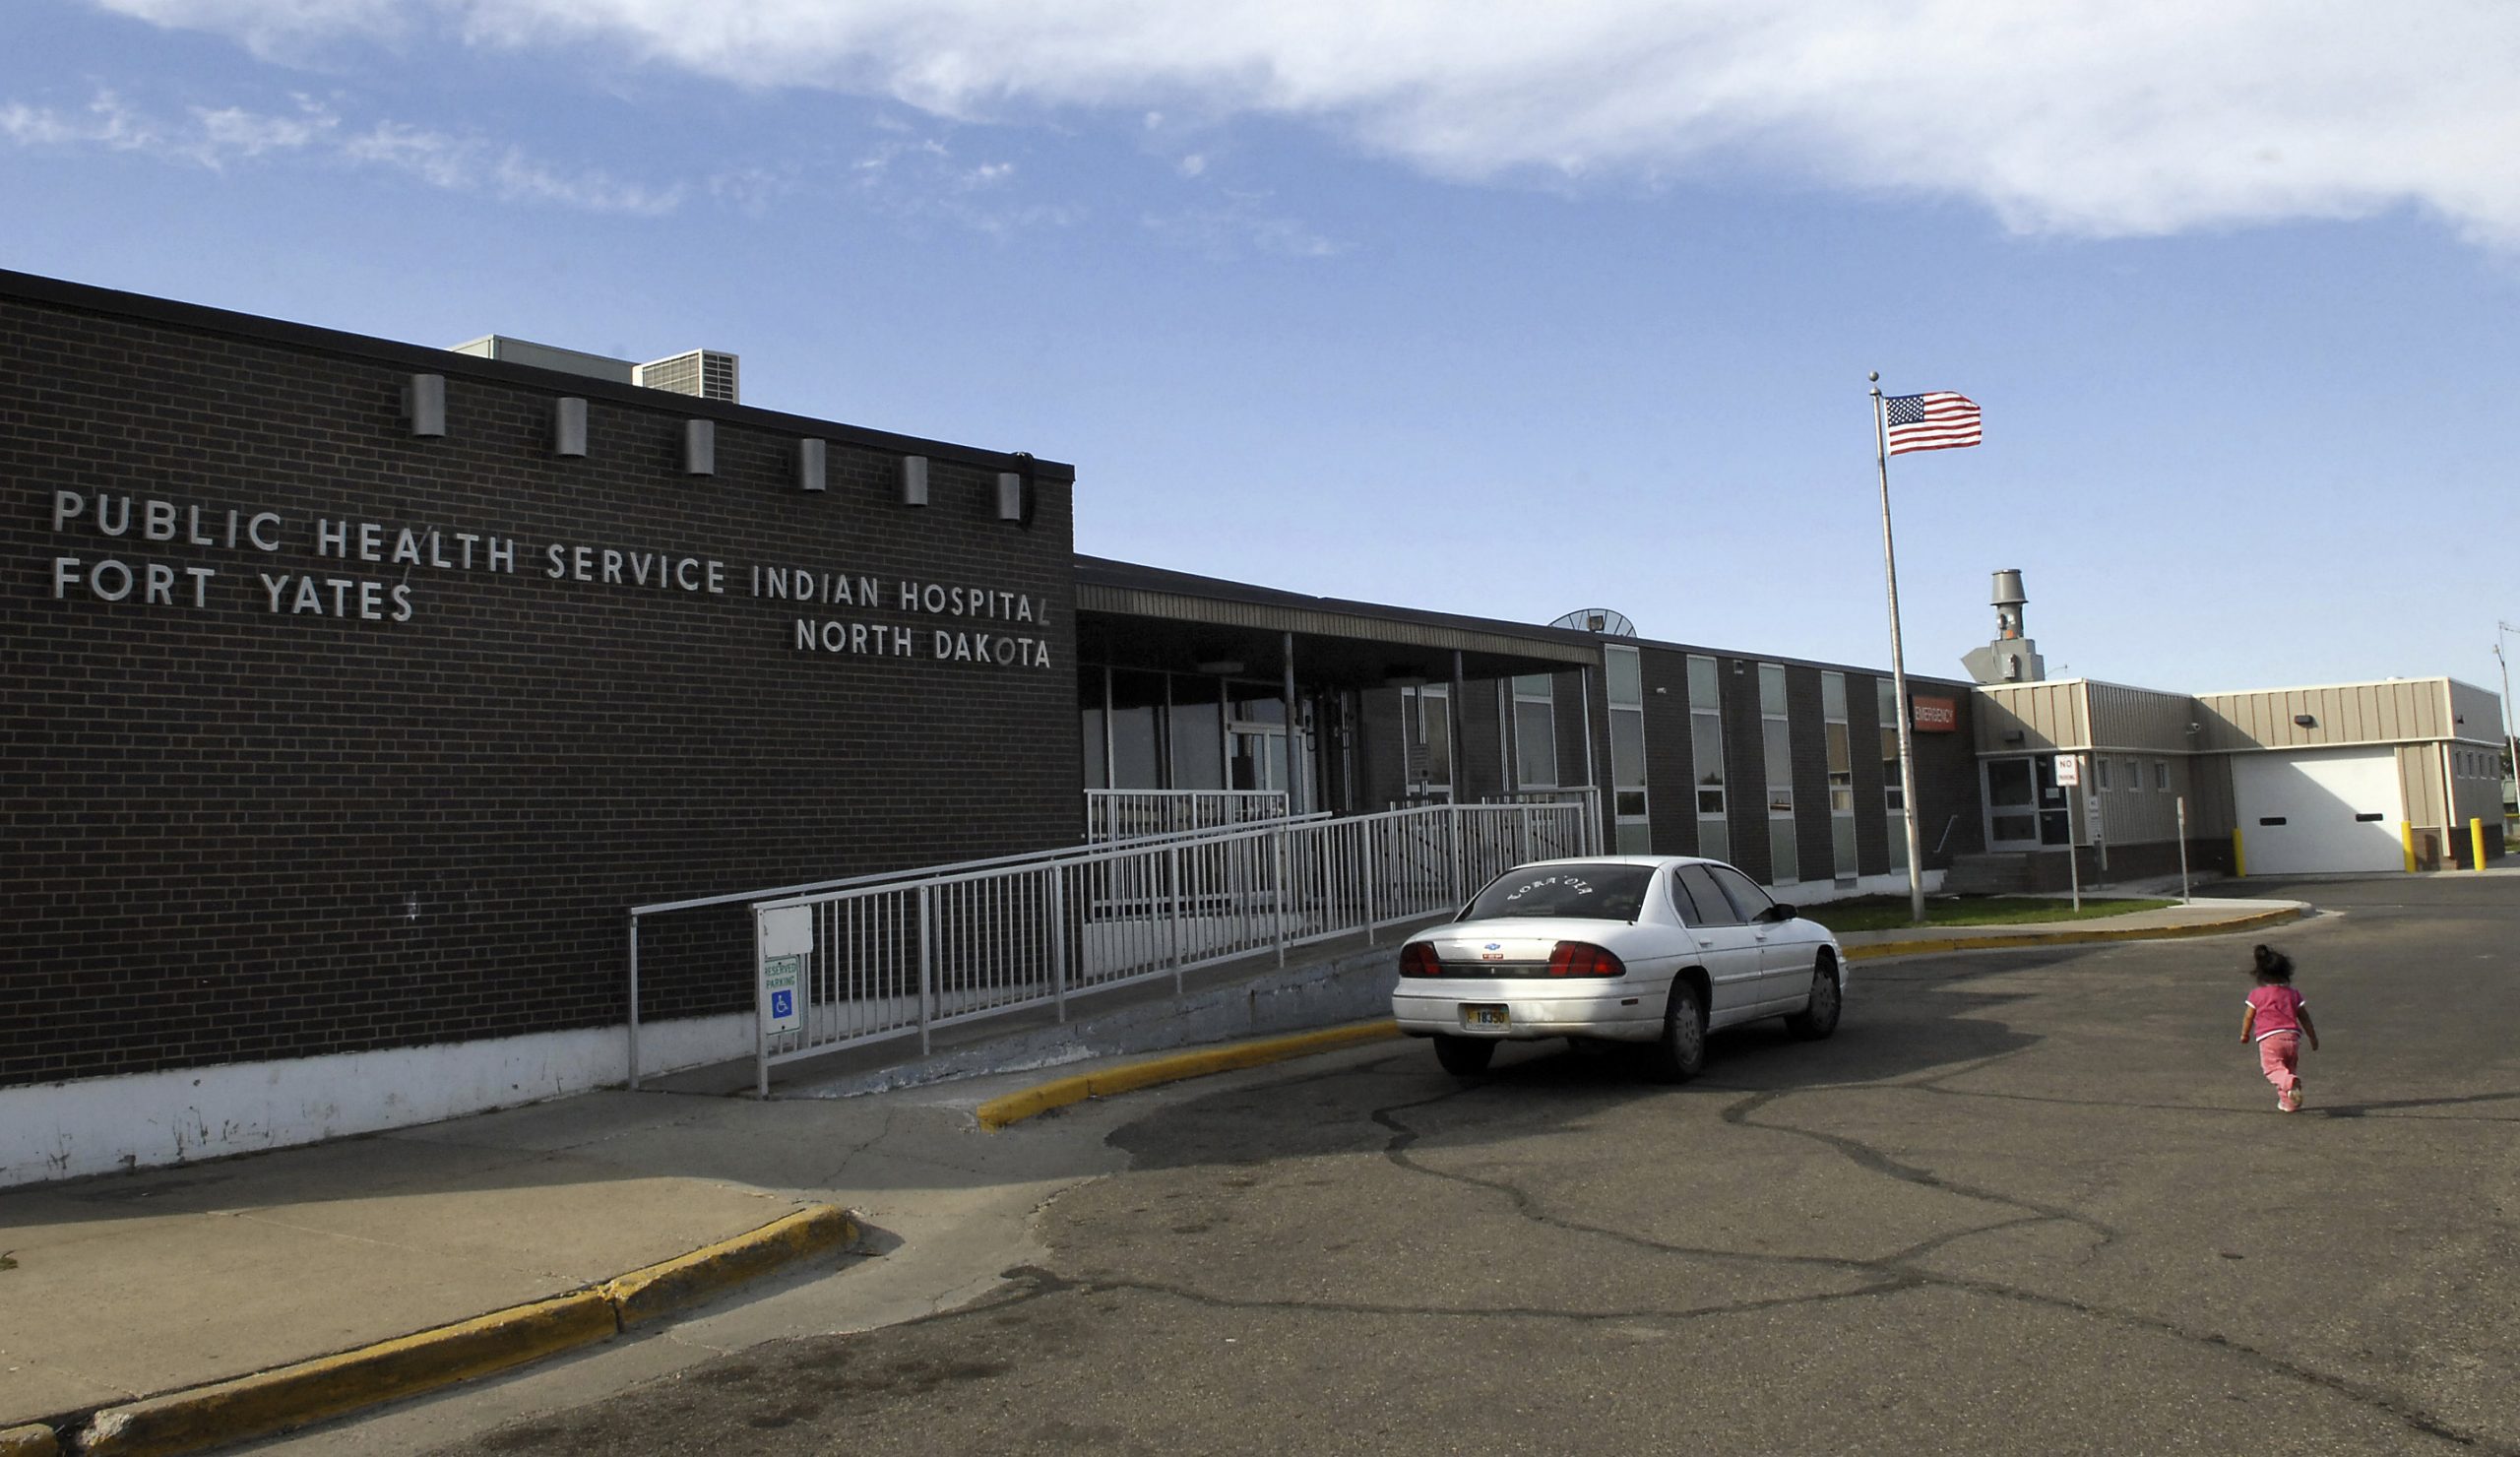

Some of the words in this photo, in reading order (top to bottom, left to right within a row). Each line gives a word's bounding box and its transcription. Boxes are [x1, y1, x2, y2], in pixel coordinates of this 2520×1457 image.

[54, 490, 281, 551] PUBLIC
[317, 518, 514, 574] HEALTH
[546, 543, 724, 594] SERVICE
[751, 565, 879, 608] INDIAN
[901, 581, 1051, 627] HOSPITAL
[54, 556, 216, 608] FORT
[260, 572, 412, 622] YATES
[795, 618, 913, 658] NORTH
[935, 630, 1051, 668] DAKOTA
[1915, 706, 1953, 723] EMERGENCY
[766, 977, 794, 988] PARKING
[1478, 1011, 1505, 1024] 18350
